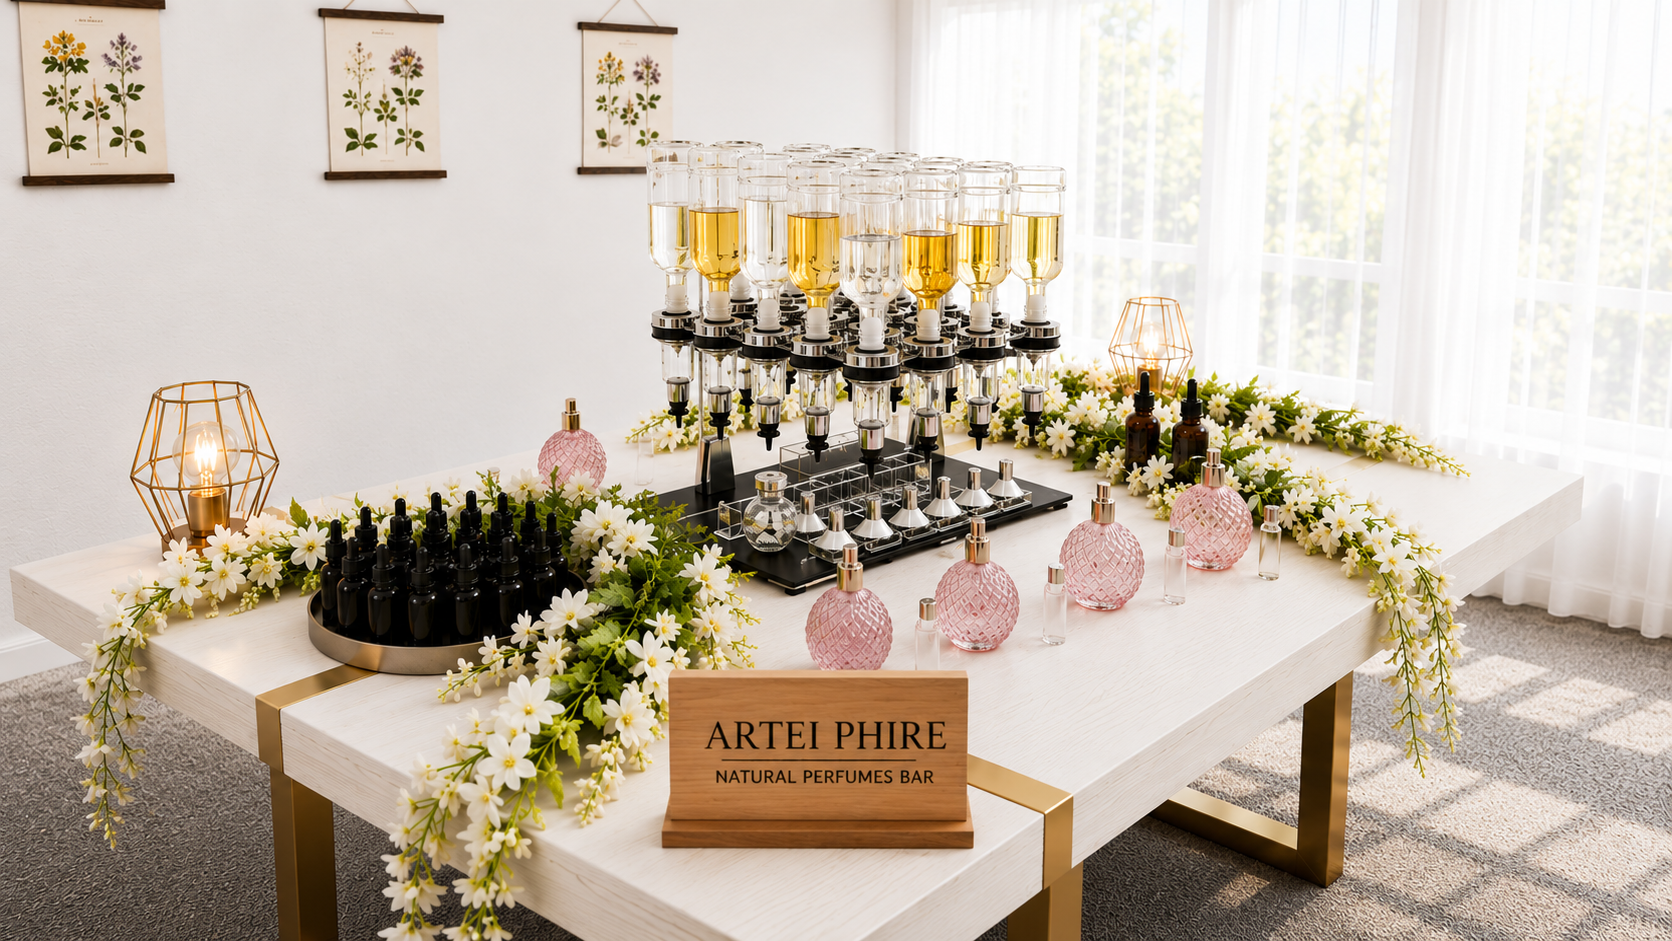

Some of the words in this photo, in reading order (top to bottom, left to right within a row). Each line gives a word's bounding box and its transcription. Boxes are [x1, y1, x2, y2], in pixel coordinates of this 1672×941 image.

[704, 720, 820, 750] ARTEI
[834, 720, 948, 750] PHIRE
[715, 769, 797, 784] NATURAL
[803, 769, 893, 784] PERFUMES
[900, 769, 935, 784] BAR
